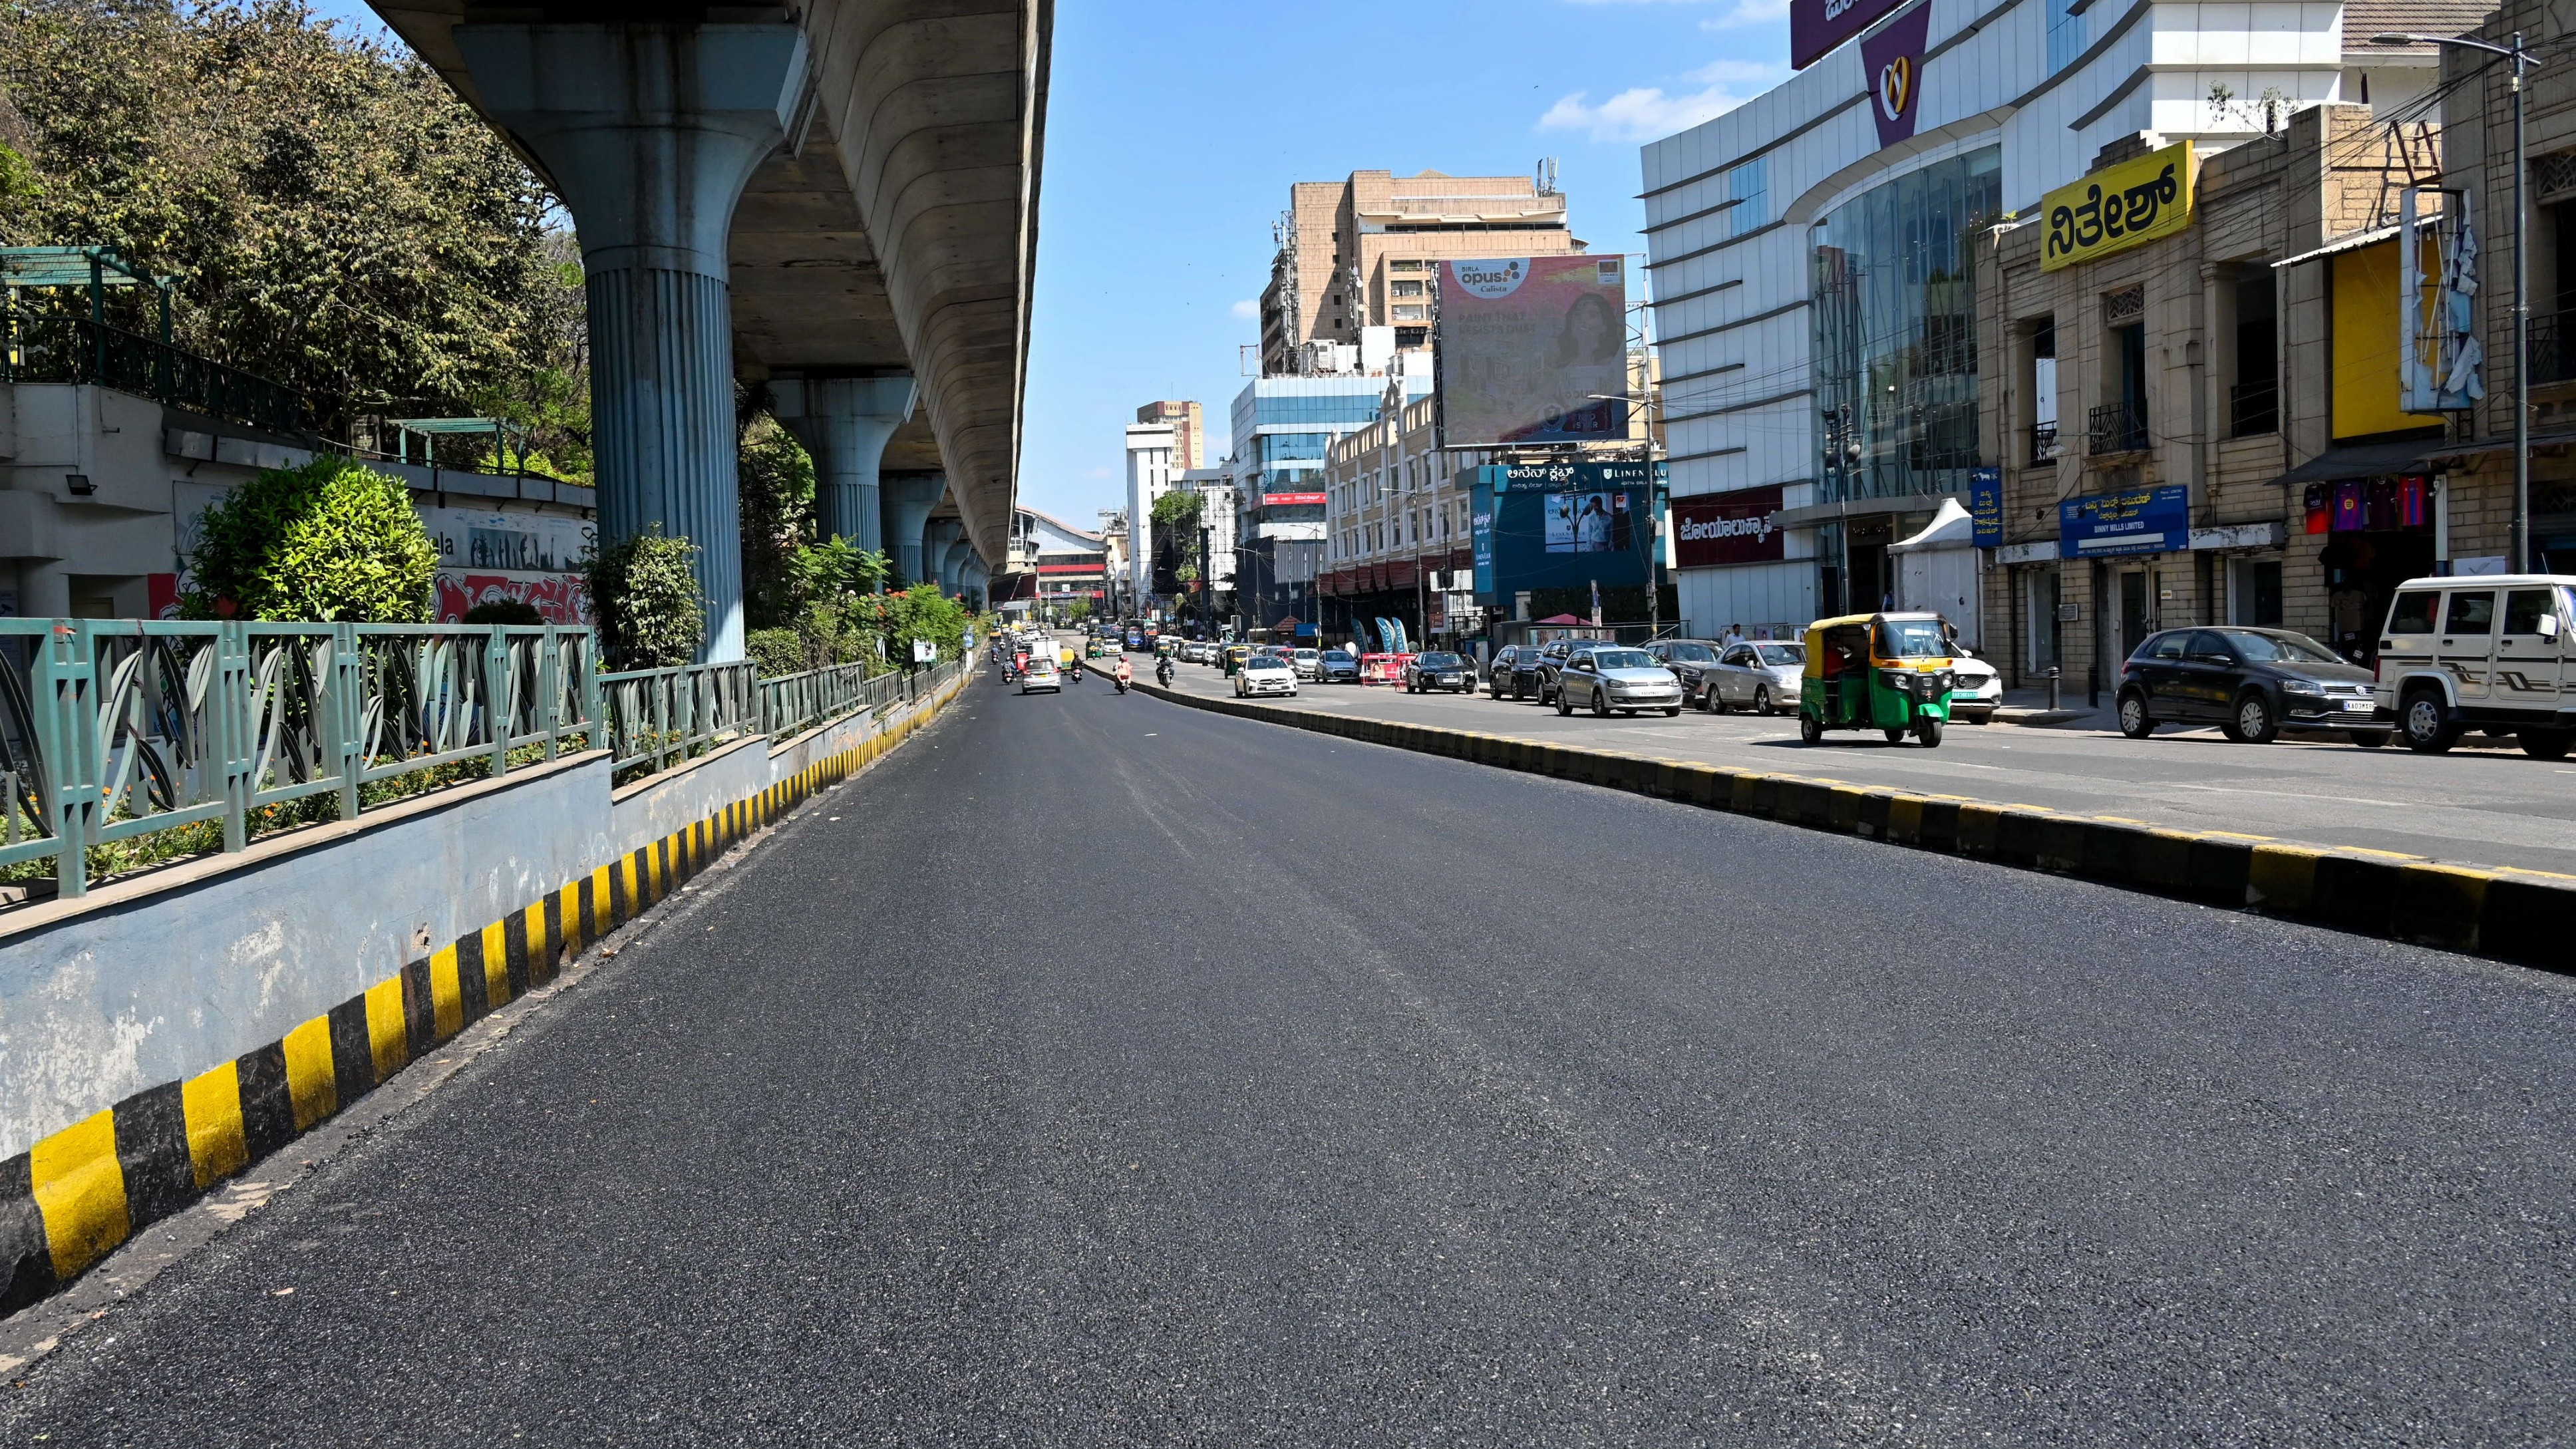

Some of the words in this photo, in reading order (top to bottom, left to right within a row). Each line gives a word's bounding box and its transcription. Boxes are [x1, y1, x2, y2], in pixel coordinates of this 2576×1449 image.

[2048, 163, 2177, 259] ನಿತೇಶ್
[1462, 272, 1502, 285] opus
[1615, 469, 1644, 478] LINEN
[2094, 524, 2109, 534] BINNY
[2110, 523, 2124, 532] MILLS
[2125, 521, 2144, 530] LIMITED
